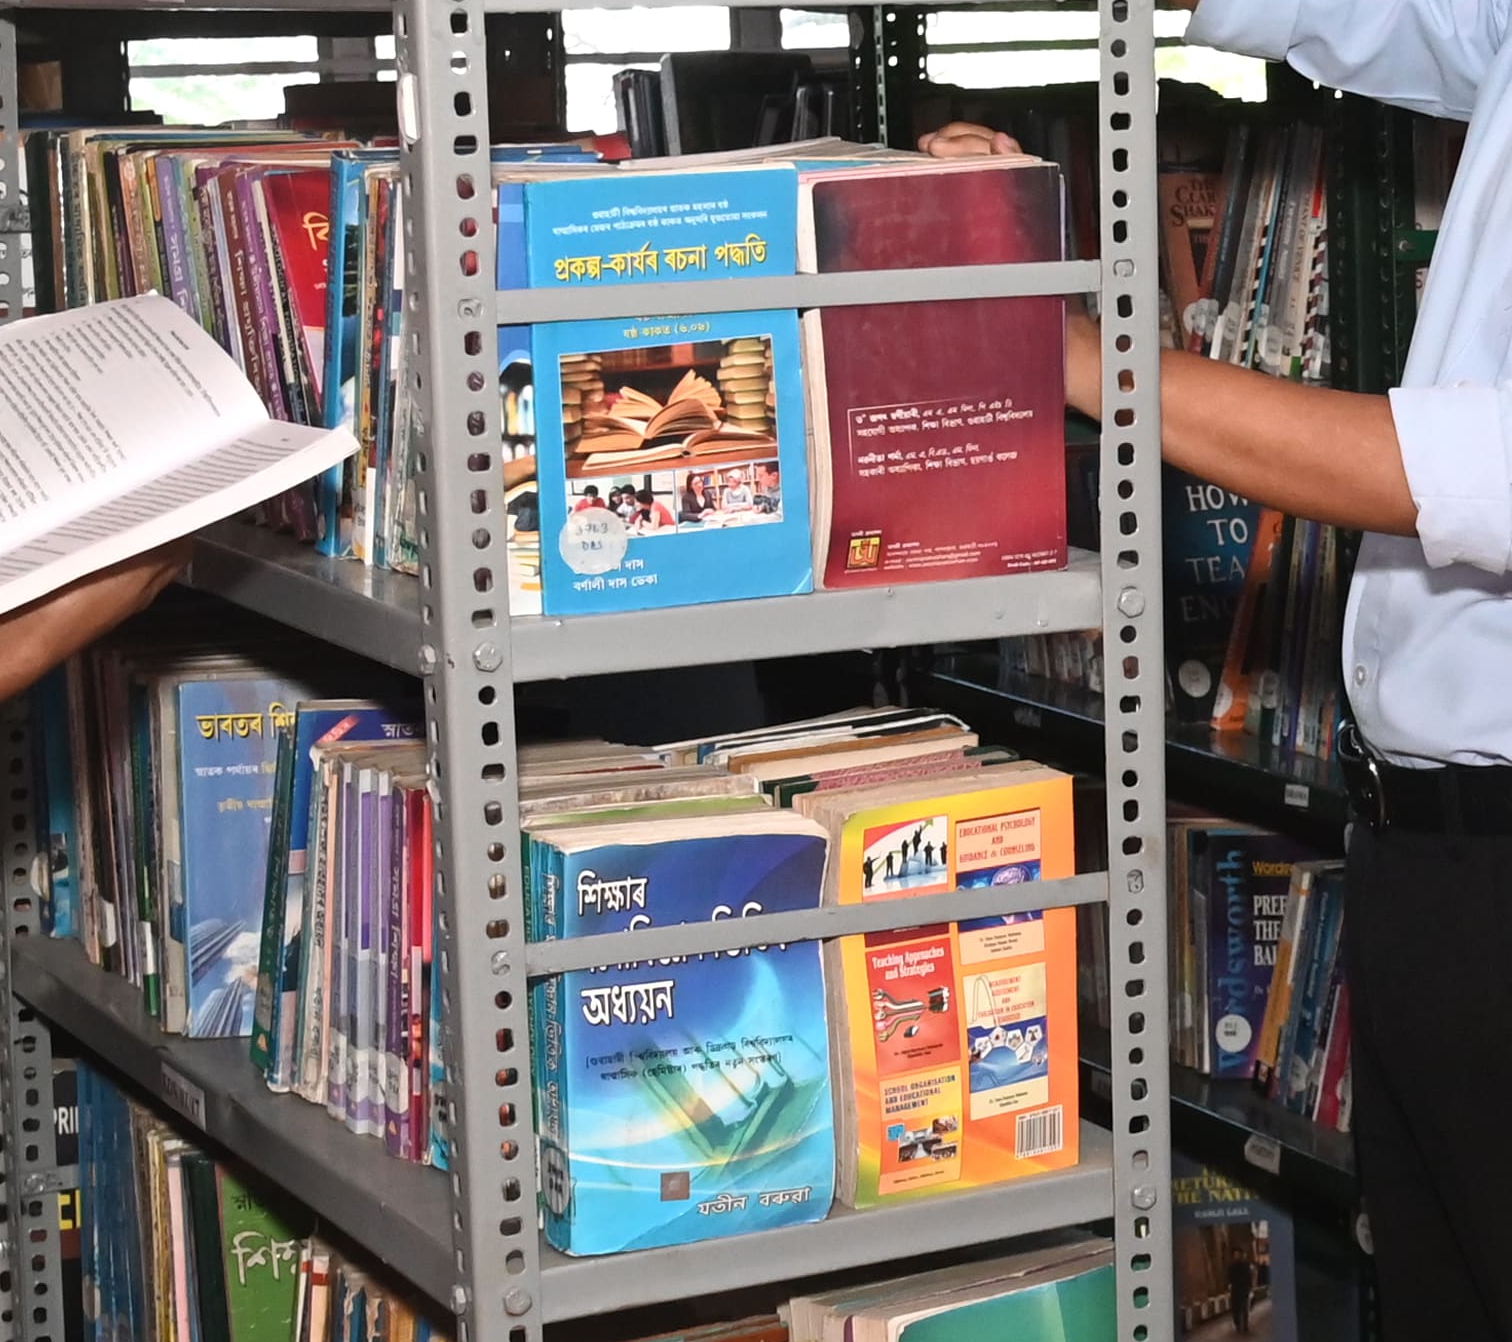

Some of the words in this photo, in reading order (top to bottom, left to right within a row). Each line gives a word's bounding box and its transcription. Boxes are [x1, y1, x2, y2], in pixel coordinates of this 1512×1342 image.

[872, 951, 904, 969] Teaching
[905, 947, 945, 963] Approaches
[885, 967, 898, 979] and
[899, 962, 935, 978] Strategies
[885, 1085, 908, 1096] SCHOOL
[910, 1075, 956, 1090] ORGANISATION
[885, 1094, 898, 1104] AND
[900, 1087, 940, 1101] EDUCATIONAL
[886, 1099, 928, 1114] MANAGEMENT
